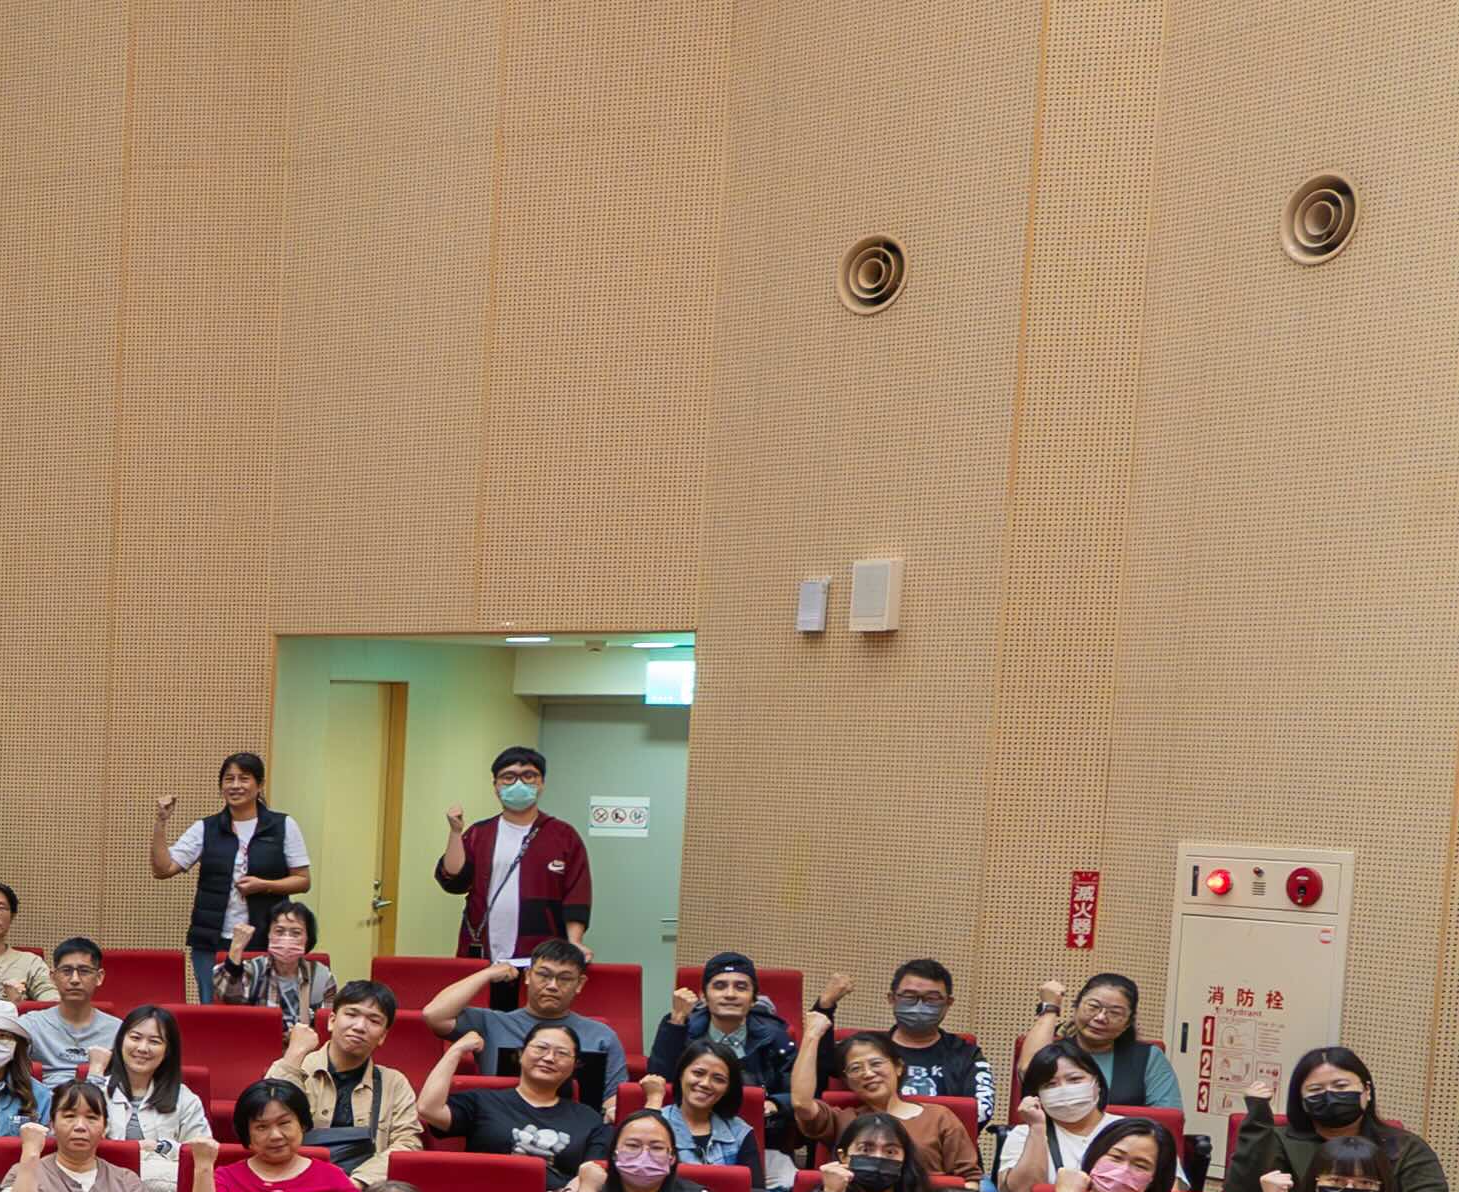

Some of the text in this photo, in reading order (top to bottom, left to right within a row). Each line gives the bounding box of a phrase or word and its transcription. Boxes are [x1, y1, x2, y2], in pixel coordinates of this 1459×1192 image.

[1072, 885, 1096, 935] 滅火器
[1208, 985, 1284, 1010] 消防栓
[1204, 1019, 1213, 1044] 1
[1201, 1052, 1212, 1077] 2
[1198, 1085, 1210, 1111] 3
